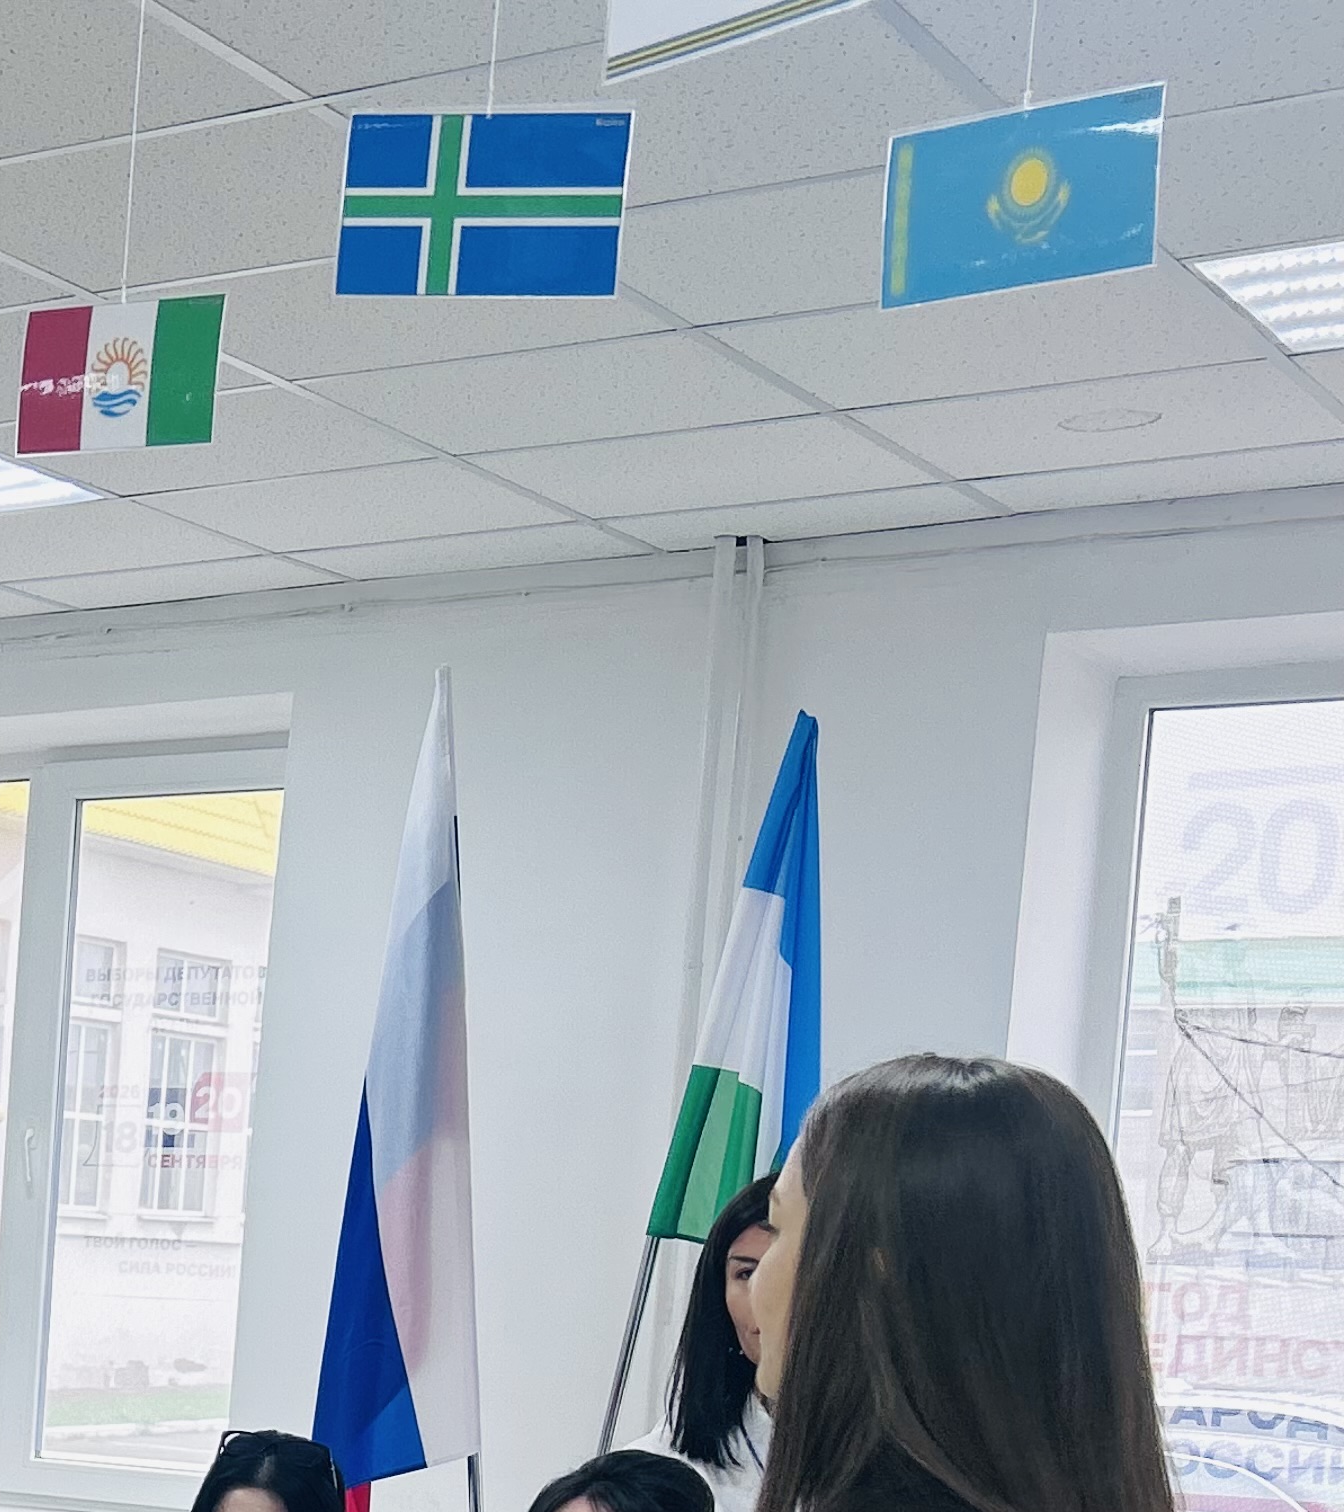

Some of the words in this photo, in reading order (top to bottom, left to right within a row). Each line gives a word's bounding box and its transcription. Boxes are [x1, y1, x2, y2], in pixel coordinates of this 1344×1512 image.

[86, 968, 159, 982] ВЫБОРЫ
[195, 1086, 242, 1119] 20
[105, 1121, 138, 1153] 18
[148, 1154, 241, 1168] СЕНТЯБРЯ
[129, 1238, 183, 1250] ГОЛОС
[118, 1261, 160, 1274] СИЛА
[1151, 1333, 1344, 1379] ЕДИНС
